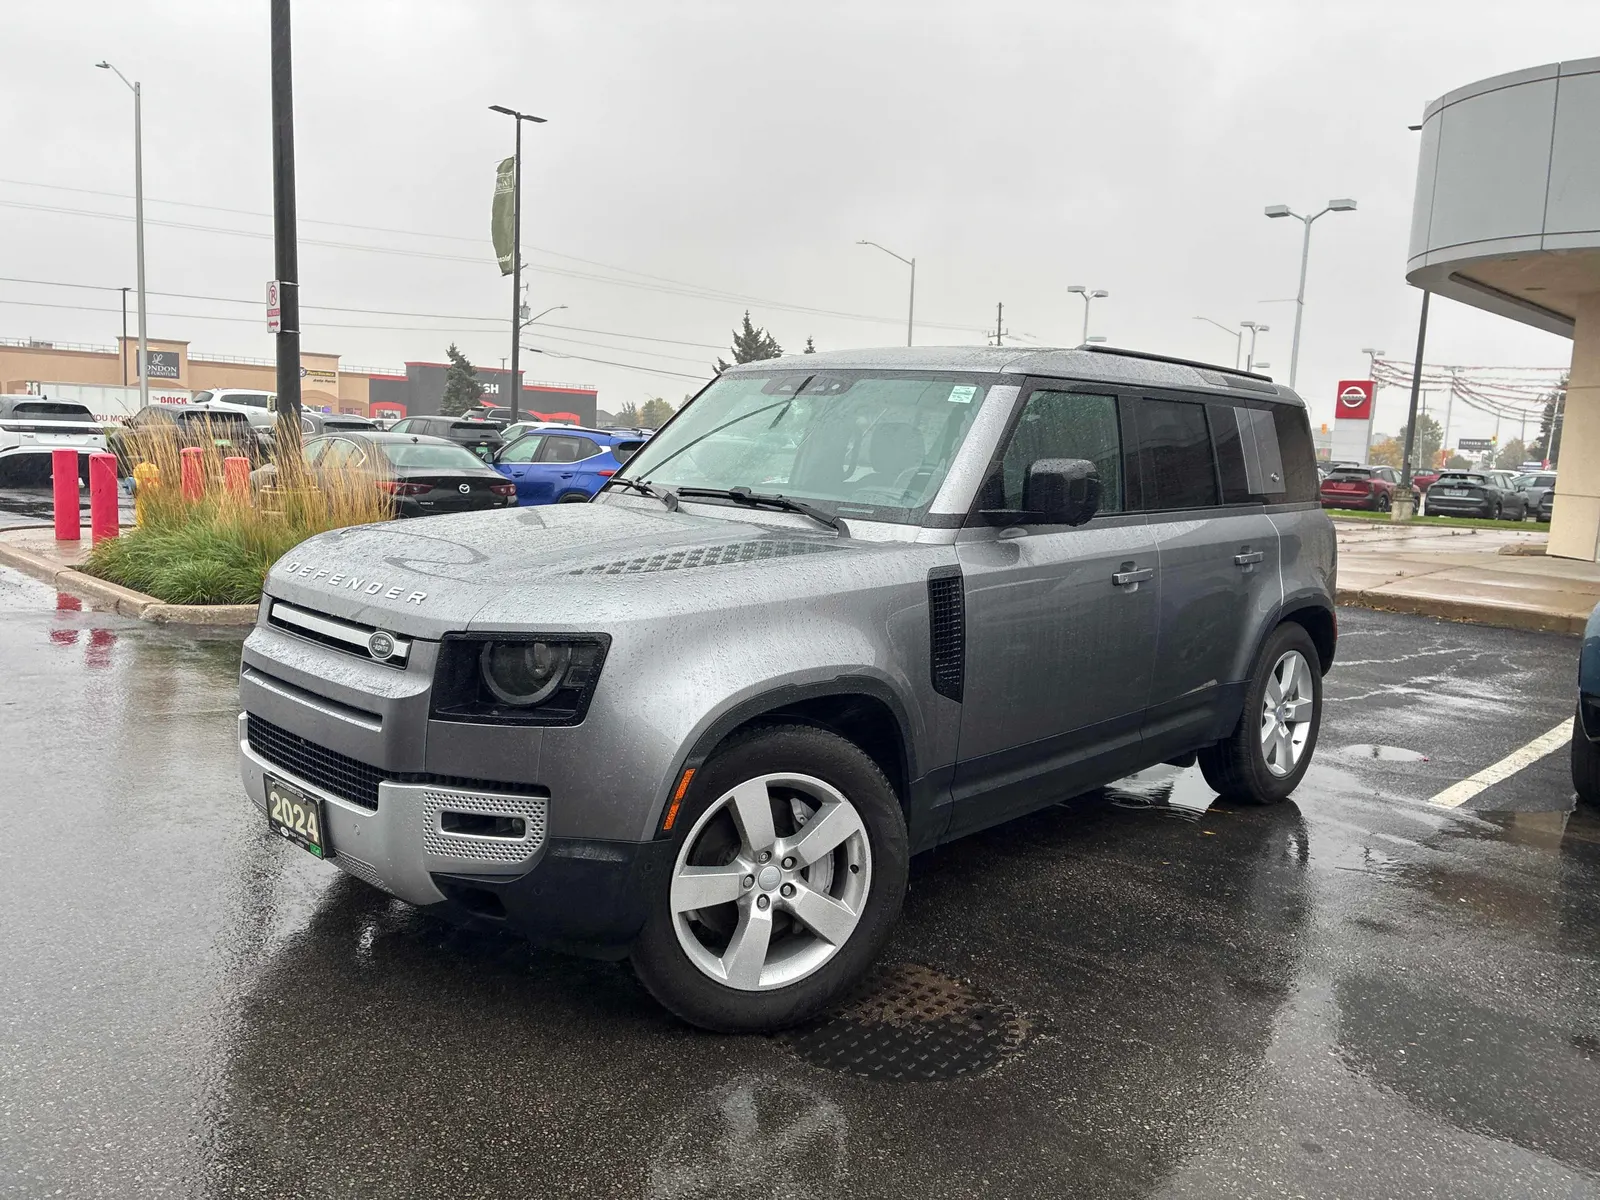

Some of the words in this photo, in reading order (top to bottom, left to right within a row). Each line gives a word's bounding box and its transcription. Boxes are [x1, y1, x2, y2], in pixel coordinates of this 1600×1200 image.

[146, 364, 177, 372] ONDON
[160, 396, 188, 405] BRICK
[285, 561, 429, 606] DEFENDER
[270, 791, 319, 843] 2024
